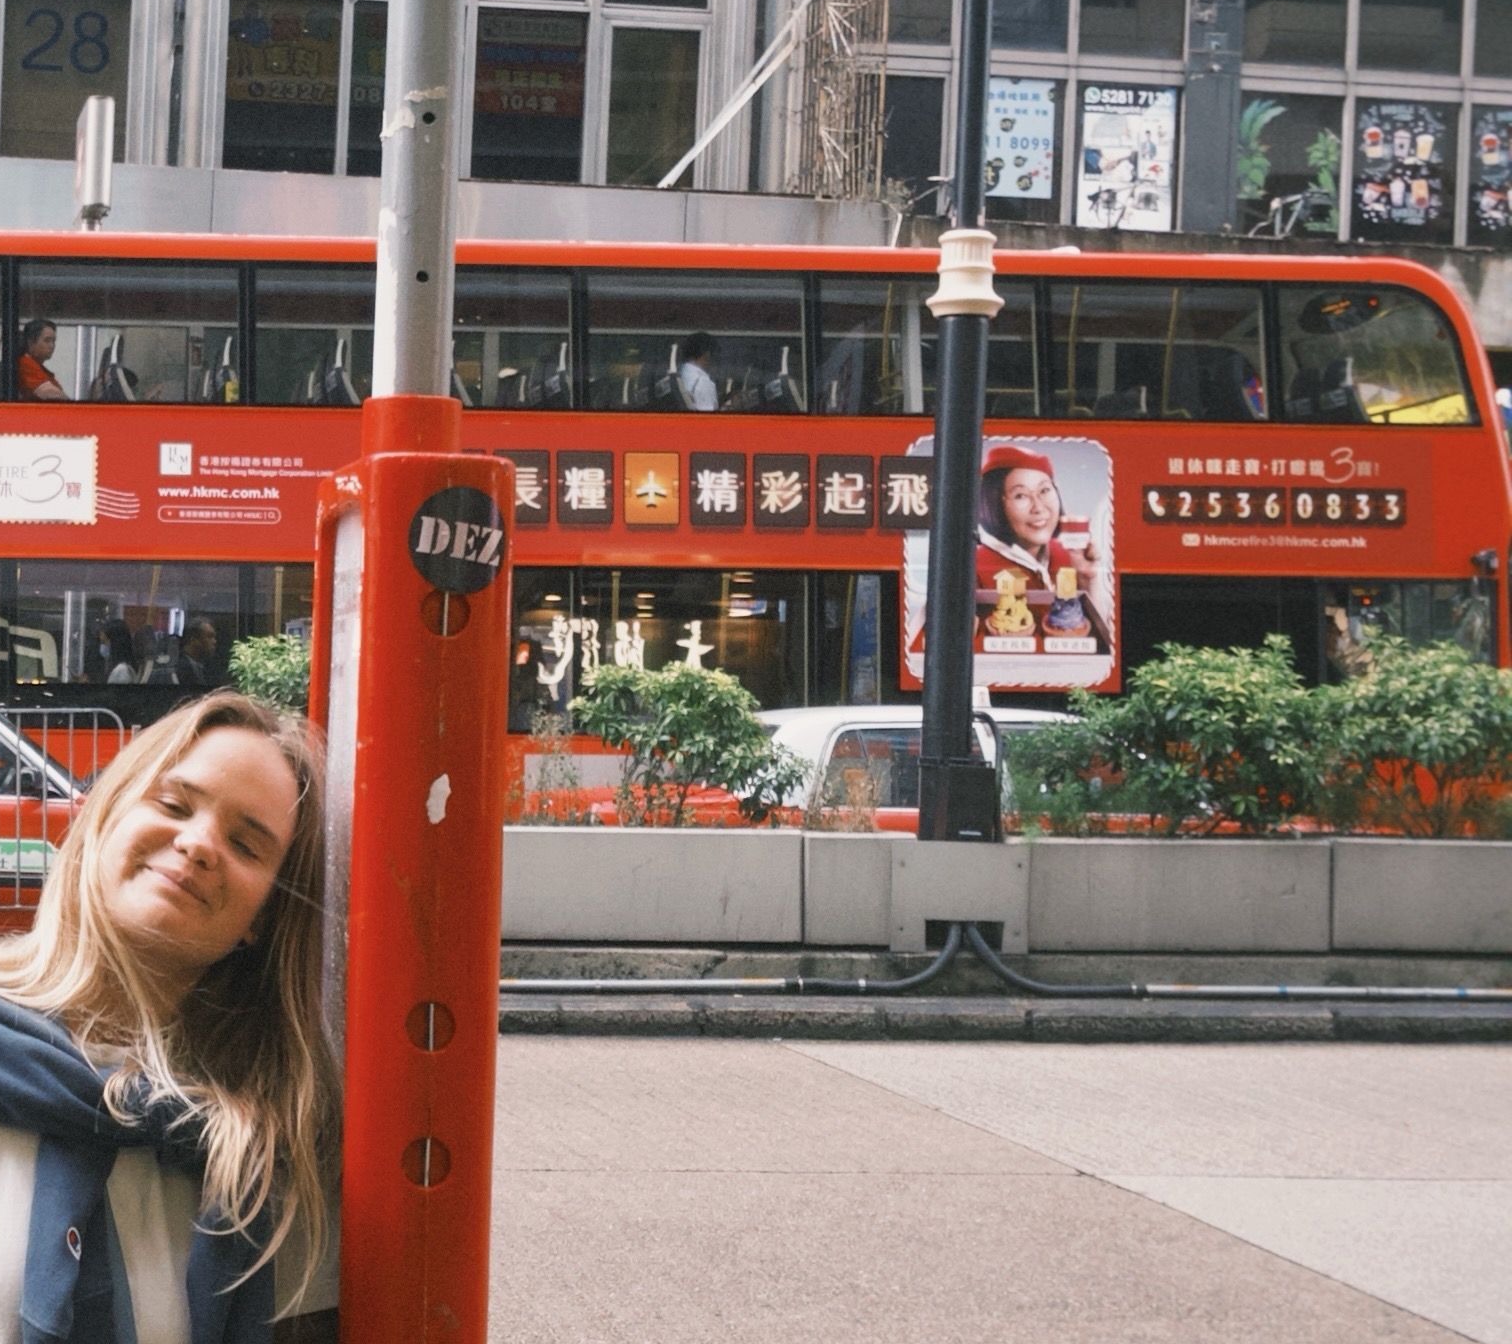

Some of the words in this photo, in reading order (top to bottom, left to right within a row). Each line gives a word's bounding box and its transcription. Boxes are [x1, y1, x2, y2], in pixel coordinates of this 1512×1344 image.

[20, 7, 111, 74] 28
[1100, 88, 1134, 105] 5281
[1010, 135, 1050, 151] 8099
[17, 455, 65, 504] 3
[158, 485, 280, 499] www.hkmc.com.hk
[696, 469, 929, 518] 精彩起飛
[1178, 491, 1280, 518] 2536
[1296, 493, 1400, 520] 0833
[415, 515, 503, 567] DEZ
